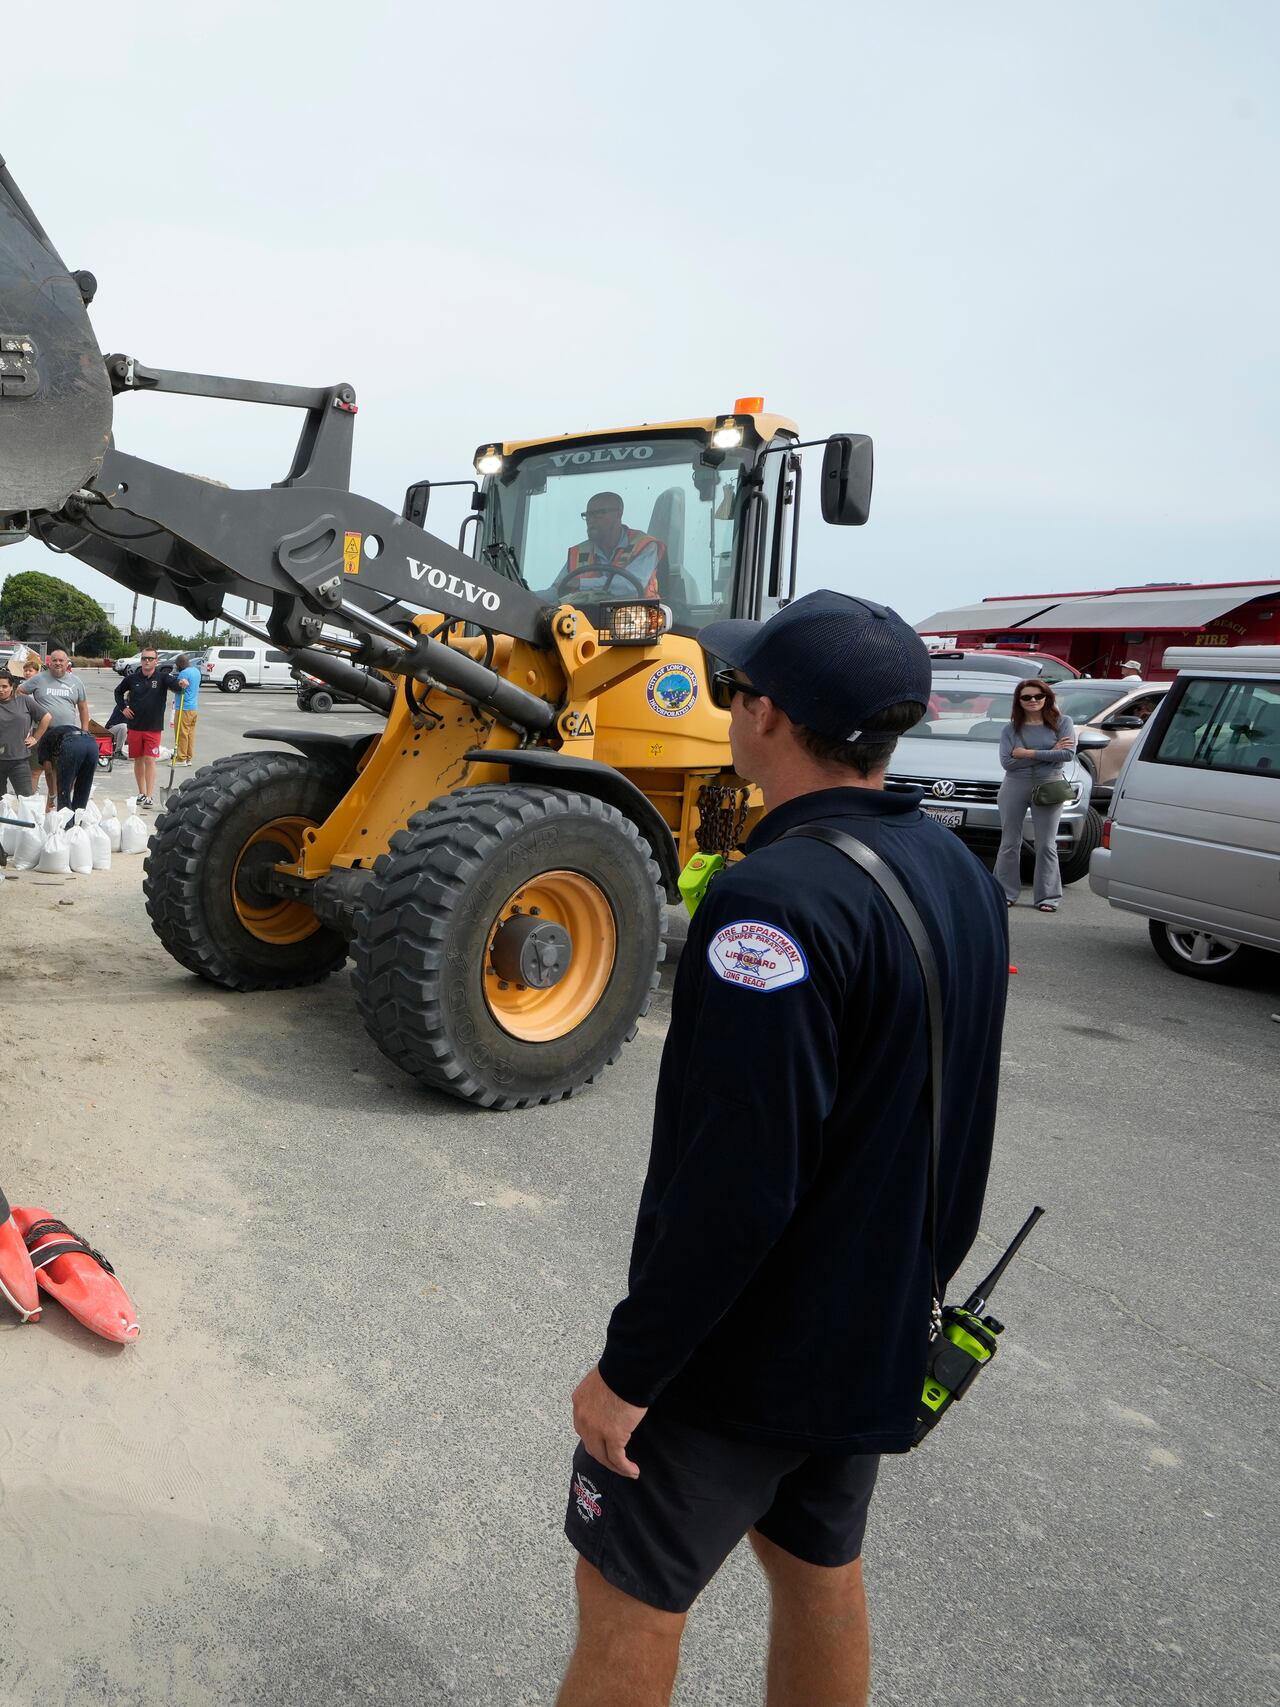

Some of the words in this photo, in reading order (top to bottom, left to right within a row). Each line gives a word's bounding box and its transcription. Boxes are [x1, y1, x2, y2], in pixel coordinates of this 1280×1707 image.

[548, 445, 654, 468] VOLVO
[405, 556, 501, 612] VOLVO
[1194, 634, 1229, 646] FIRE
[648, 676, 658, 691] CITY
[656, 668, 665, 677] OF
[46, 688, 70, 697] PUMA
[717, 926, 737, 942] FIRE
[741, 925, 801, 963] DEPARTMENT
[755, 935, 785, 956] PARATUS
[725, 950, 777, 970] LIFEGUARD
[723, 970, 741, 981] LONG
[742, 975, 767, 989] BEACH
